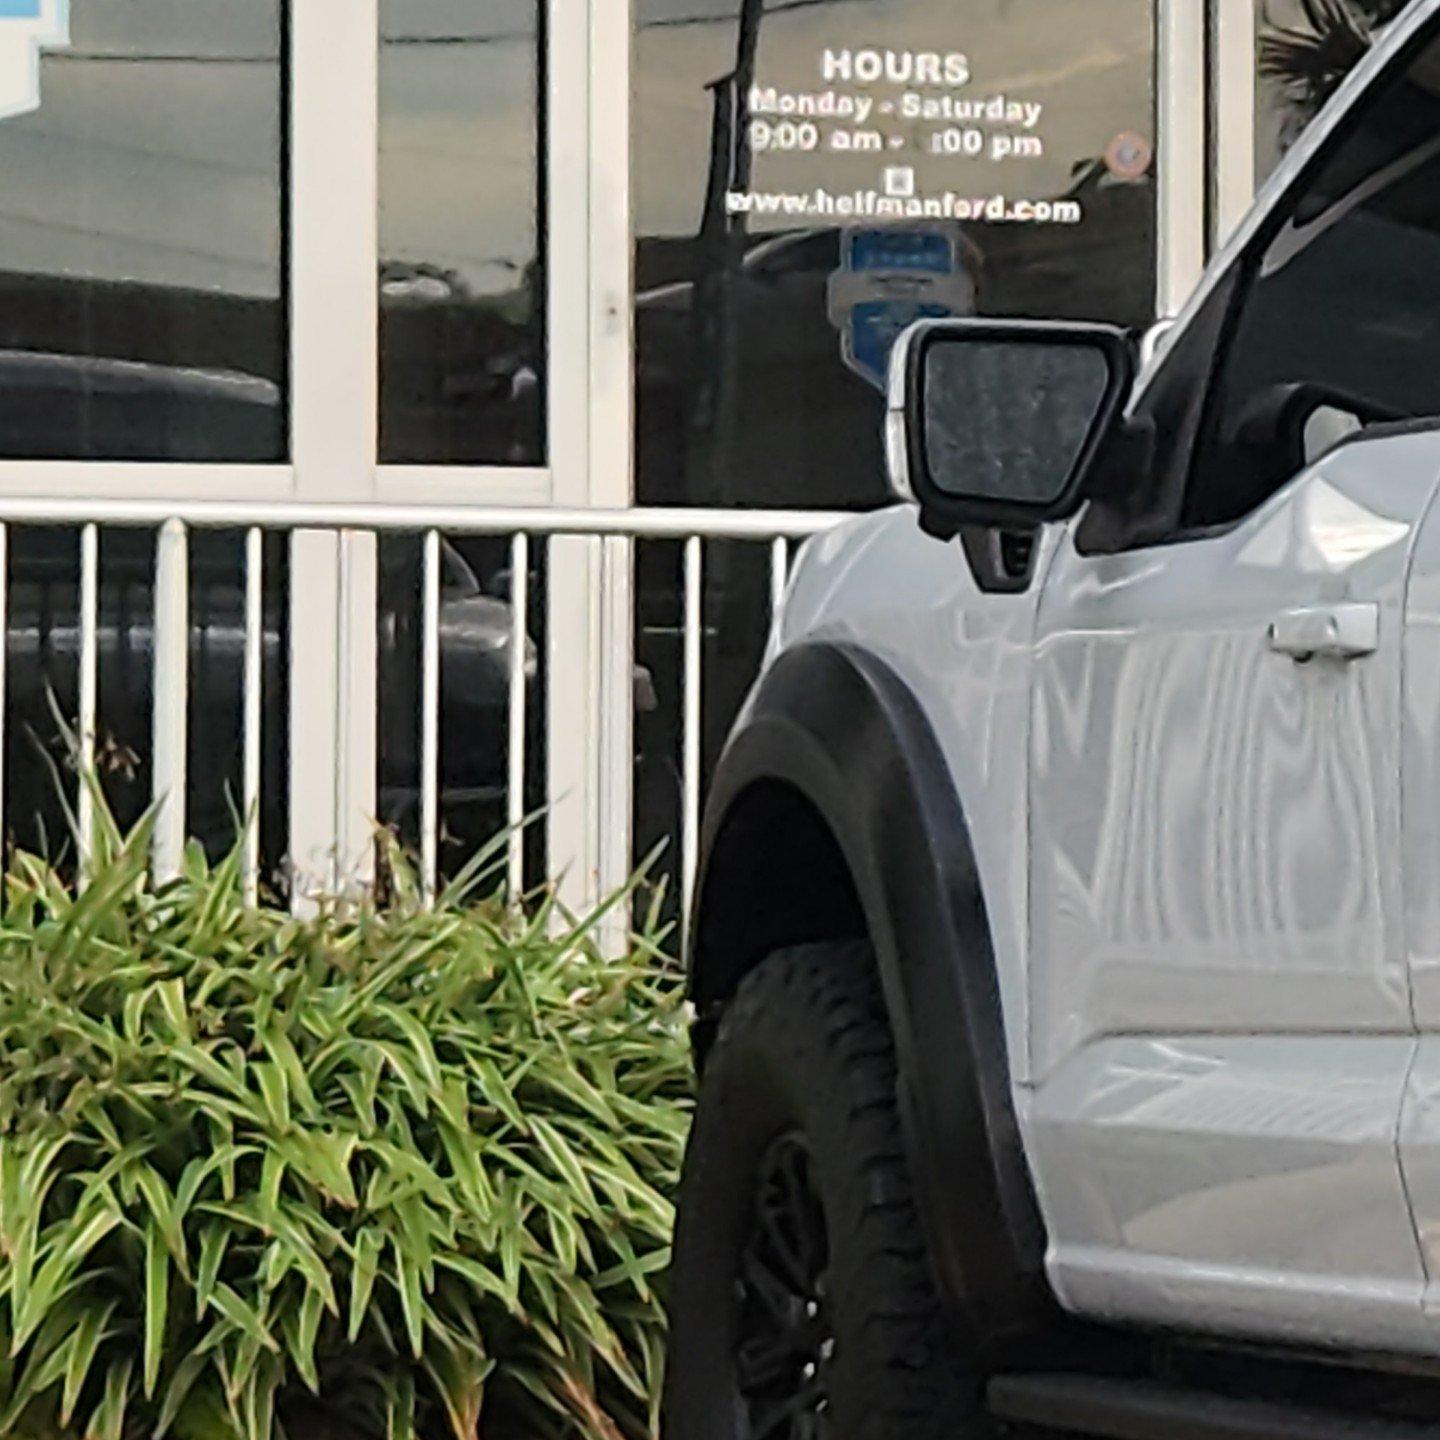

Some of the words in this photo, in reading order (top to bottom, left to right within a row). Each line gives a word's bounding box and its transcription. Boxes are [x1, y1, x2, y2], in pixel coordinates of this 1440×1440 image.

[822, 49, 970, 85] HOURS
[750, 88, 873, 122] Monday
[901, 93, 1042, 127] Saturday
[750, 120, 819, 151] 9:00
[831, 128, 882, 150] am
[992, 134, 1042, 160] pm
[726, 187, 1081, 222] www.helfmanford.com
